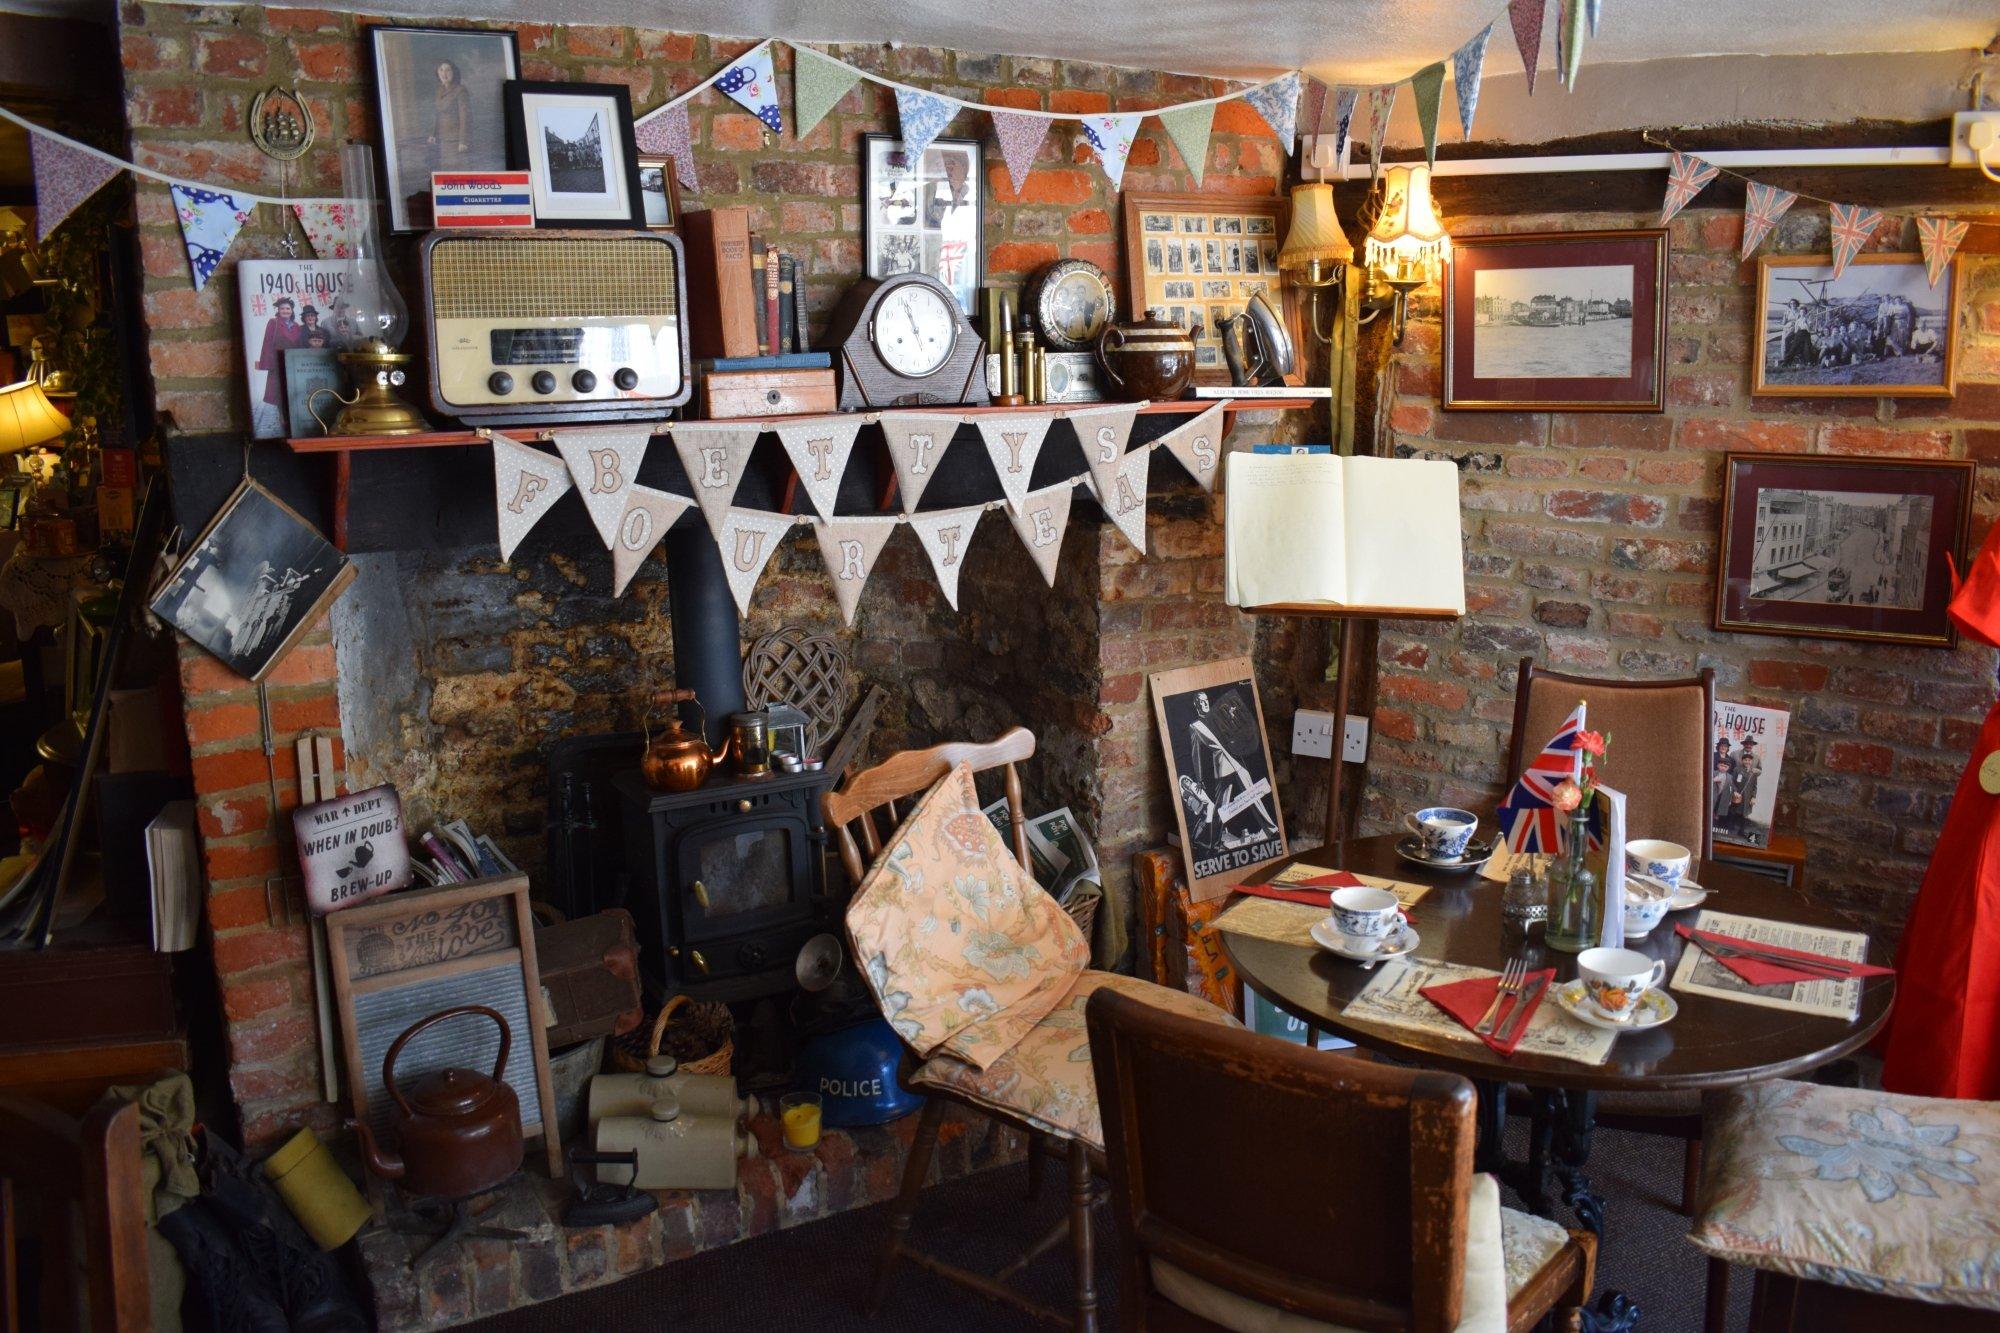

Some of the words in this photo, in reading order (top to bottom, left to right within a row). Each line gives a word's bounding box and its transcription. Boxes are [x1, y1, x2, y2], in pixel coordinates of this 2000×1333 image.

[260, 273, 300, 294] 1940s
[1724, 705, 1736, 713] THE
[1725, 712, 1766, 735] HOUSE
[315, 810, 339, 825] WAR
[353, 798, 382, 815] DEPT
[303, 834, 341, 857] WHEN
[345, 829, 357, 845] IN
[1194, 853, 1231, 879] SERVE
[1232, 849, 1249, 866] TO
[1251, 840, 1283, 862] SAVE
[331, 869, 393, 903] BREW-UP
[820, 1077, 882, 1097] POLICE
